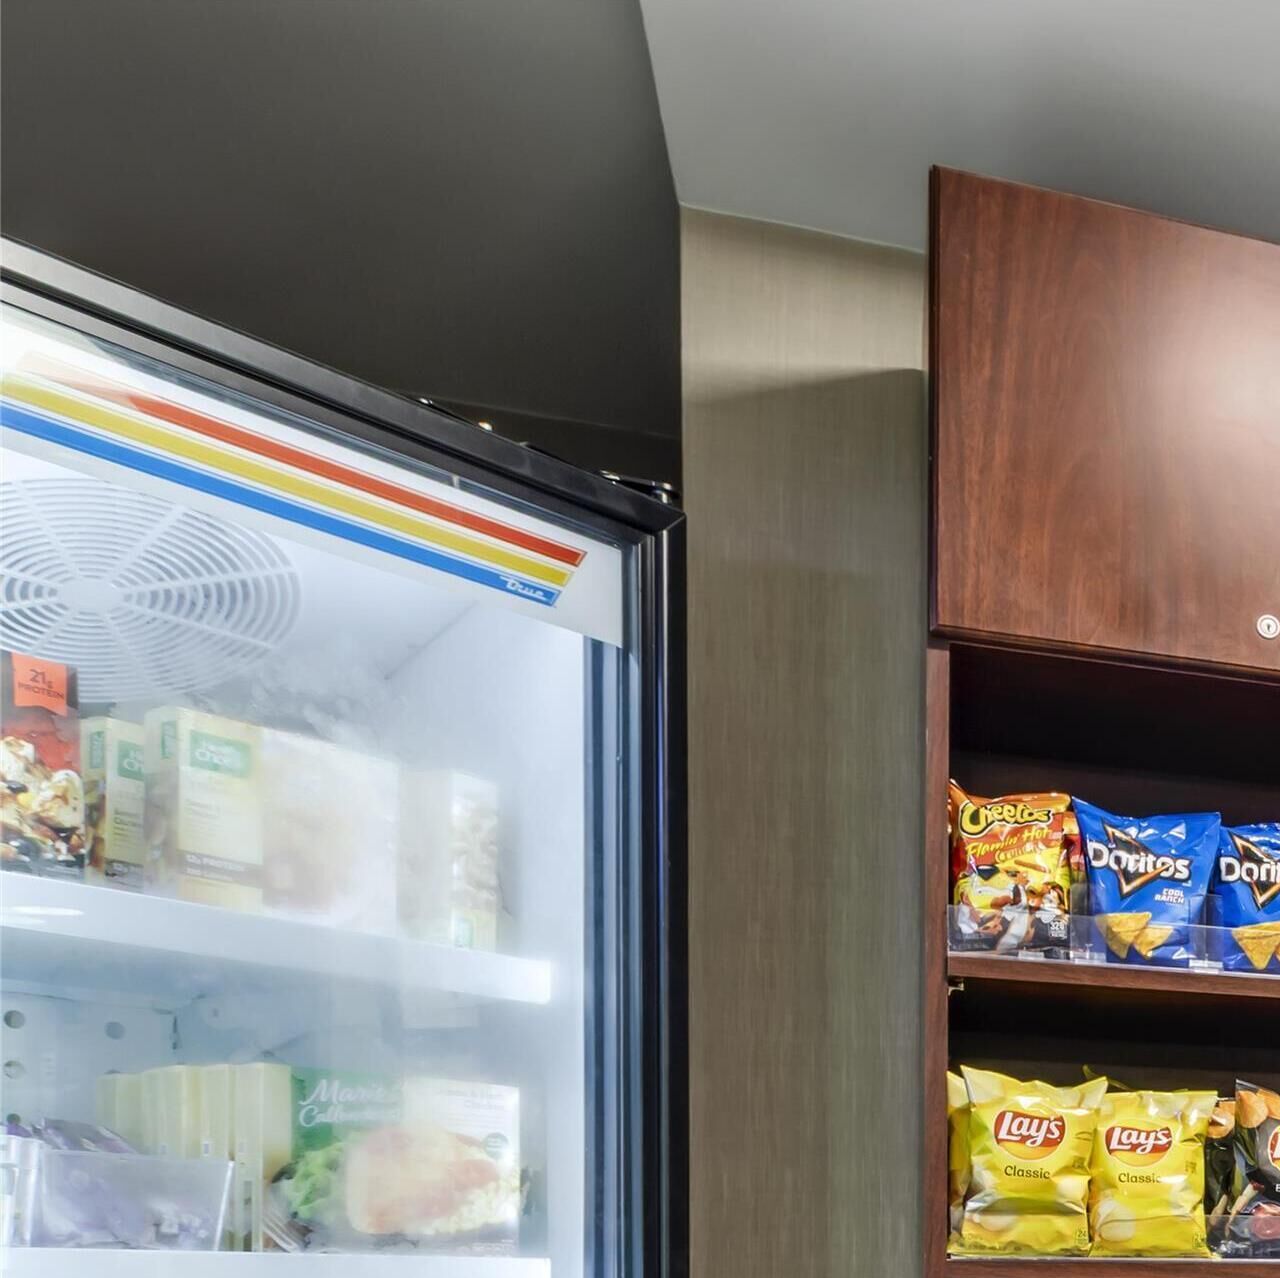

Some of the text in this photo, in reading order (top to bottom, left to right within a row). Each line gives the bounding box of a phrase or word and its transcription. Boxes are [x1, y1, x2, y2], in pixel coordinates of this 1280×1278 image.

[18, 682, 64, 700] PROTEIN
[960, 802, 1051, 836] Cheetos
[1022, 826, 1048, 842] Hot
[1087, 841, 1191, 880] Doritos
[1155, 894, 1184, 905] RANCH
[998, 1111, 1062, 1147] Lay's
[1108, 1125, 1171, 1155] Lay's
[1004, 1165, 1050, 1181] Classic
[1118, 1172, 1162, 1184] Classic
